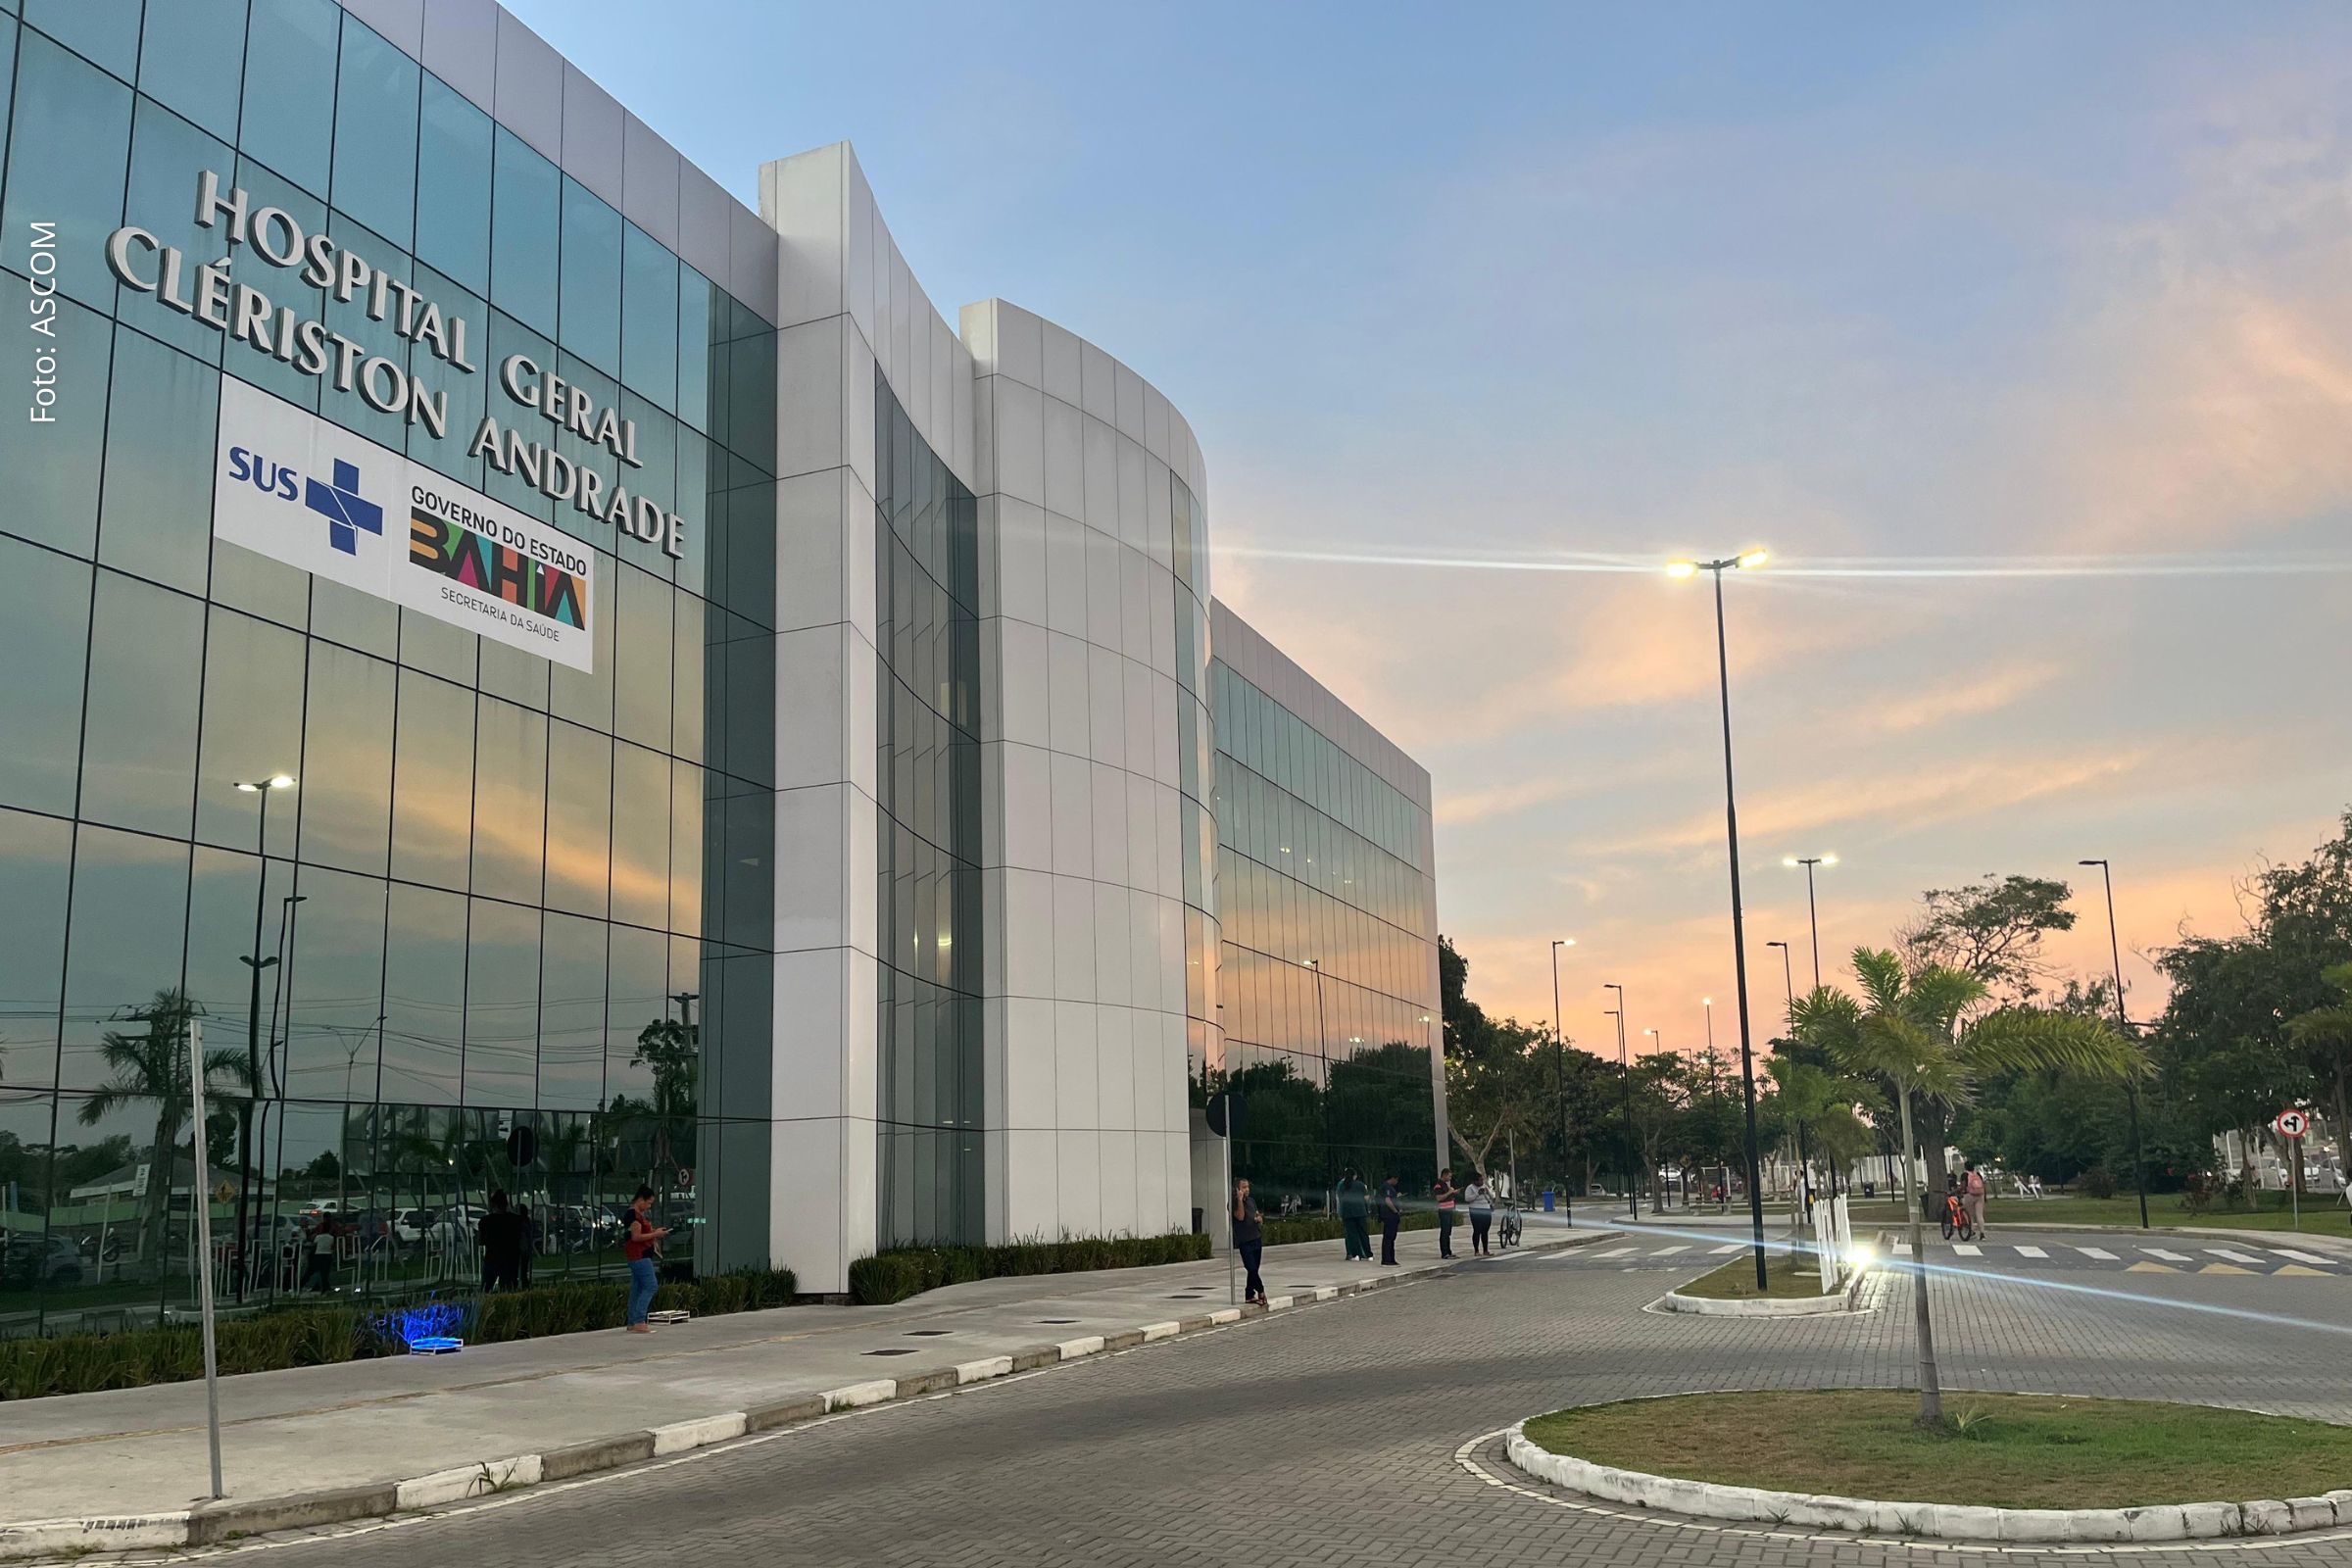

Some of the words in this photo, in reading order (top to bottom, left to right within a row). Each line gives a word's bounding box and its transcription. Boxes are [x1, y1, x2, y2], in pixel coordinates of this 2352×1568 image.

[195, 170, 475, 373] HOSPITAL
[500, 354, 643, 468] GERAL
[105, 226, 447, 440] CLÉRISTON
[467, 416, 684, 561] ANDRADE
[228, 446, 299, 501] SUS
[412, 485, 497, 537] GOVERNO
[503, 525, 525, 550] DO
[530, 538, 587, 576] ESTADO
[441, 587, 508, 621] SECRETARIA
[511, 613, 524, 629] DA
[526, 619, 560, 642] SAÚDE
